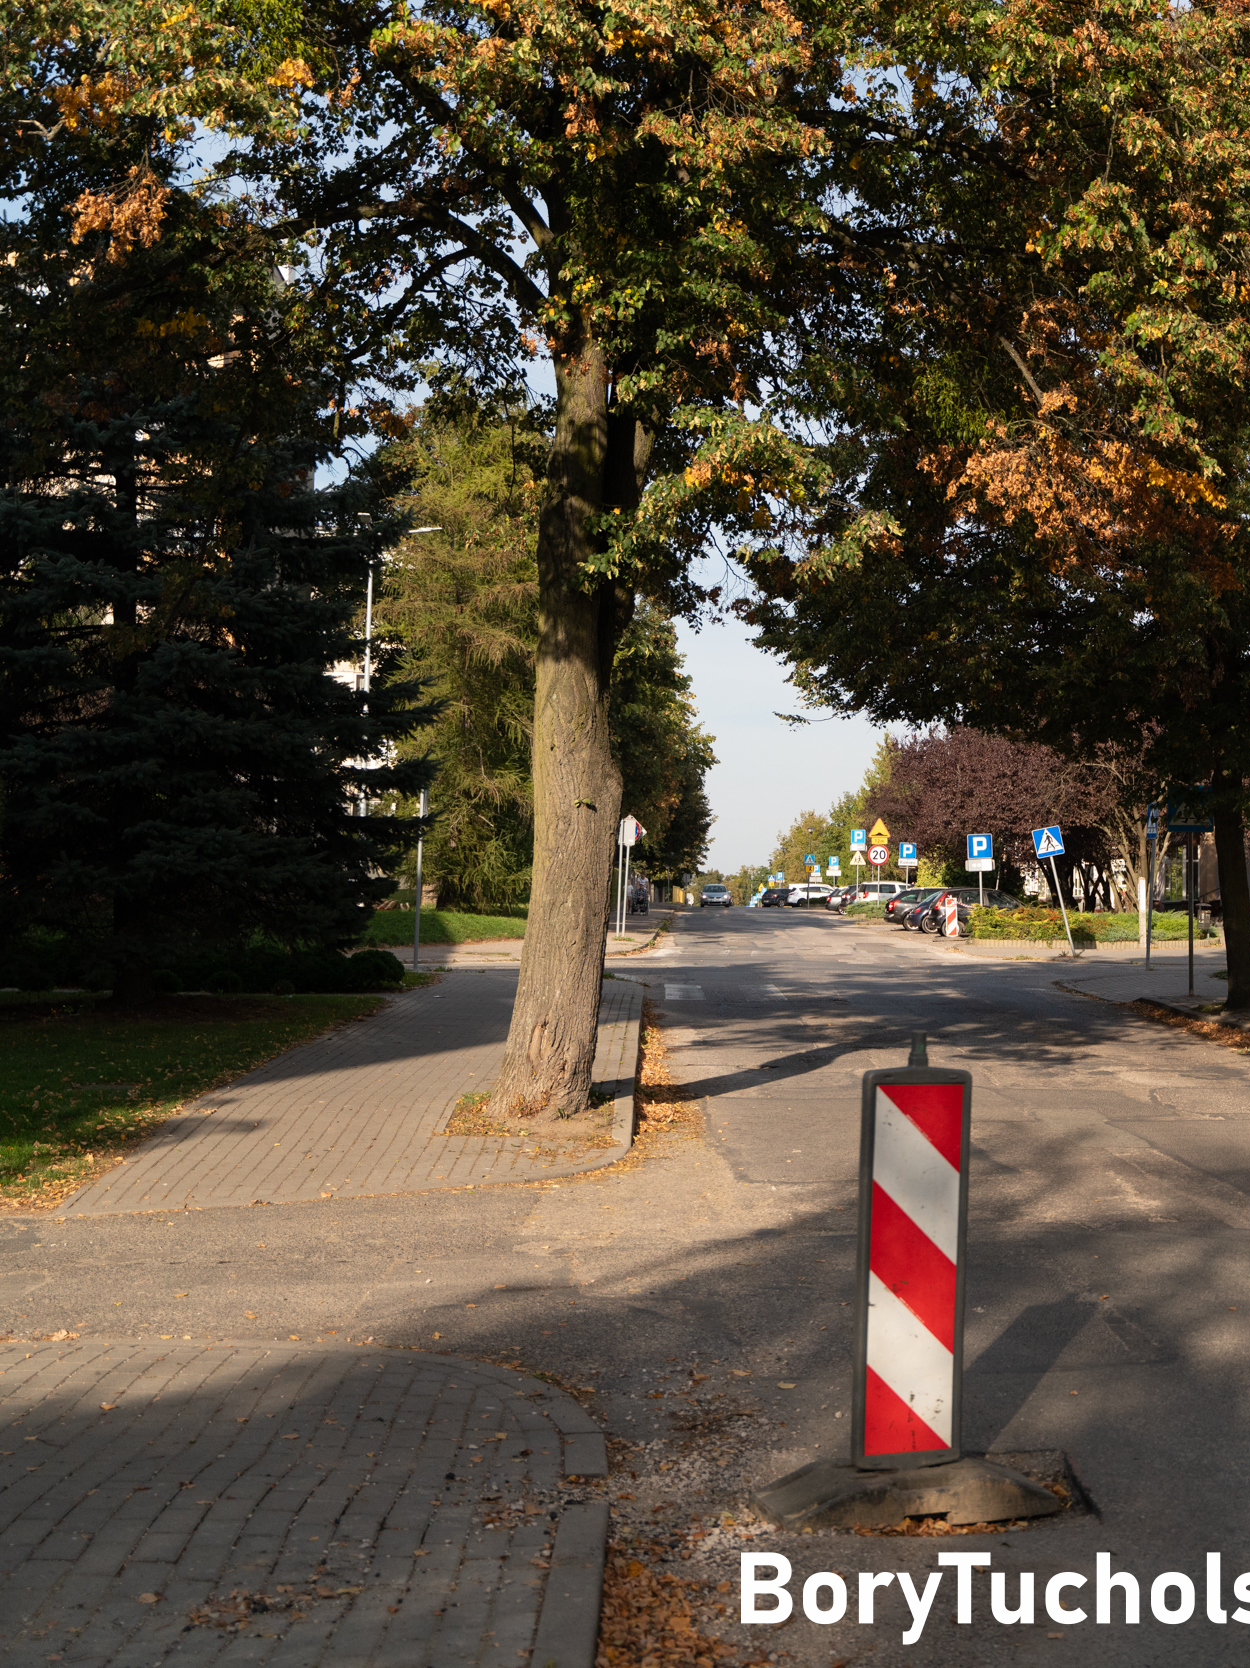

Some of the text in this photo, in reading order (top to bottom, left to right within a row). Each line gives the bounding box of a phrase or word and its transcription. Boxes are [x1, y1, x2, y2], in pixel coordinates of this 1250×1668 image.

[903, 844, 913, 858] P
[972, 837, 987, 856] P
[872, 850, 886, 860] 20
